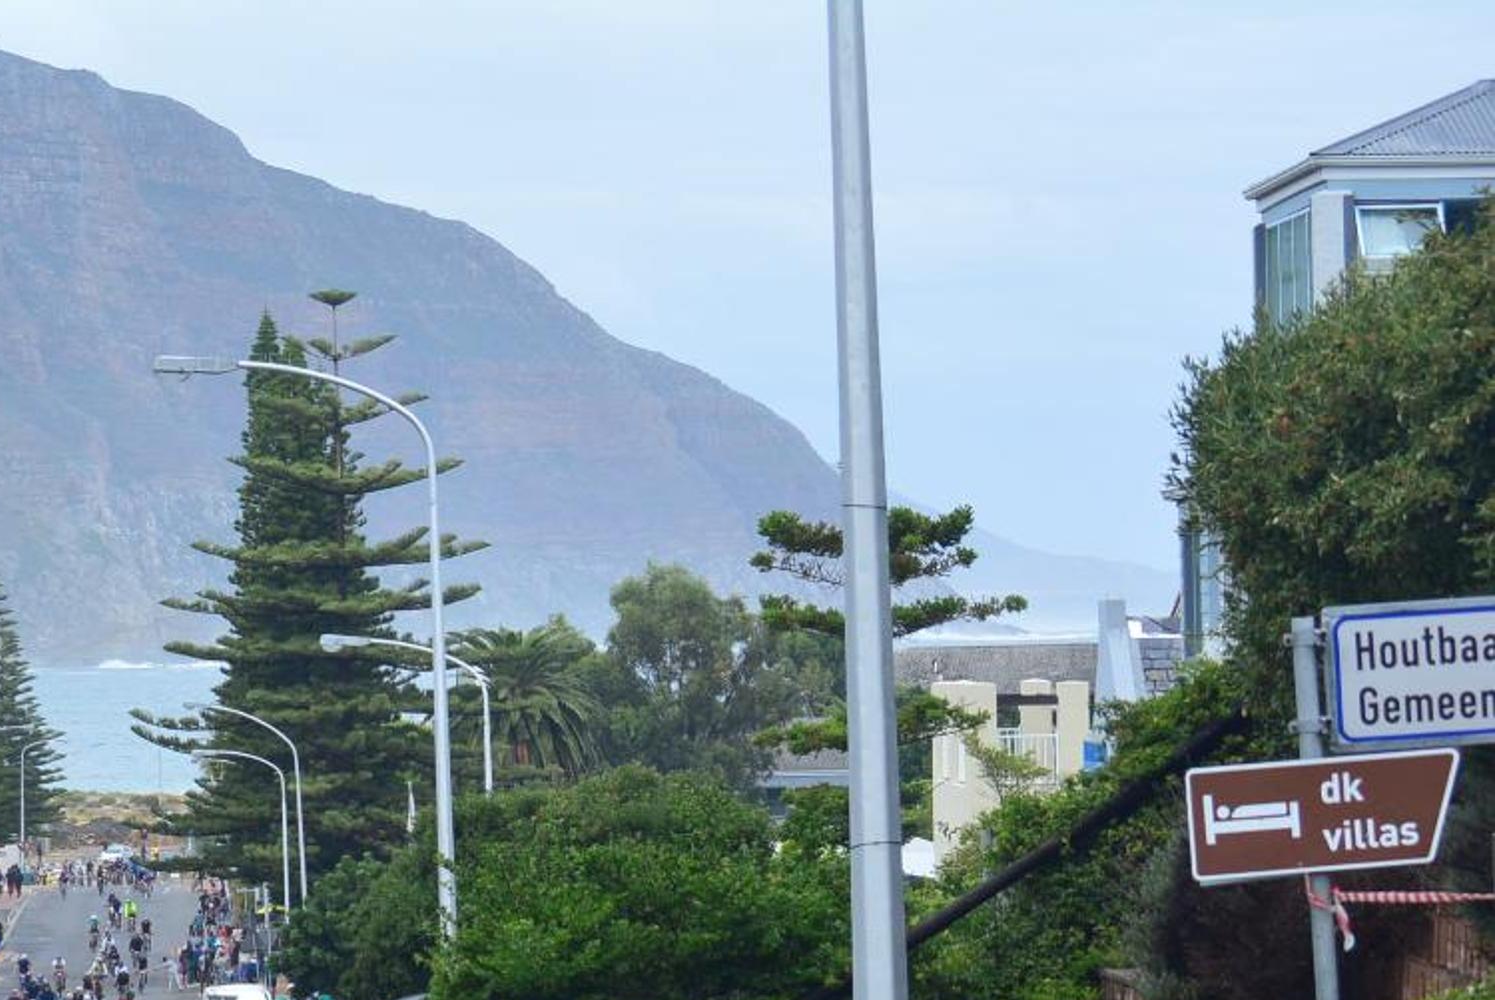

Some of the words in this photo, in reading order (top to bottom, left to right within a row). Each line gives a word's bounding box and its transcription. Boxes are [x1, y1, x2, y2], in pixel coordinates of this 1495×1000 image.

[1355, 625, 1495, 671] Houtbaa
[1359, 686, 1495, 726] Gemeen
[1321, 771, 1364, 804] dk
[1322, 818, 1420, 852] villas
